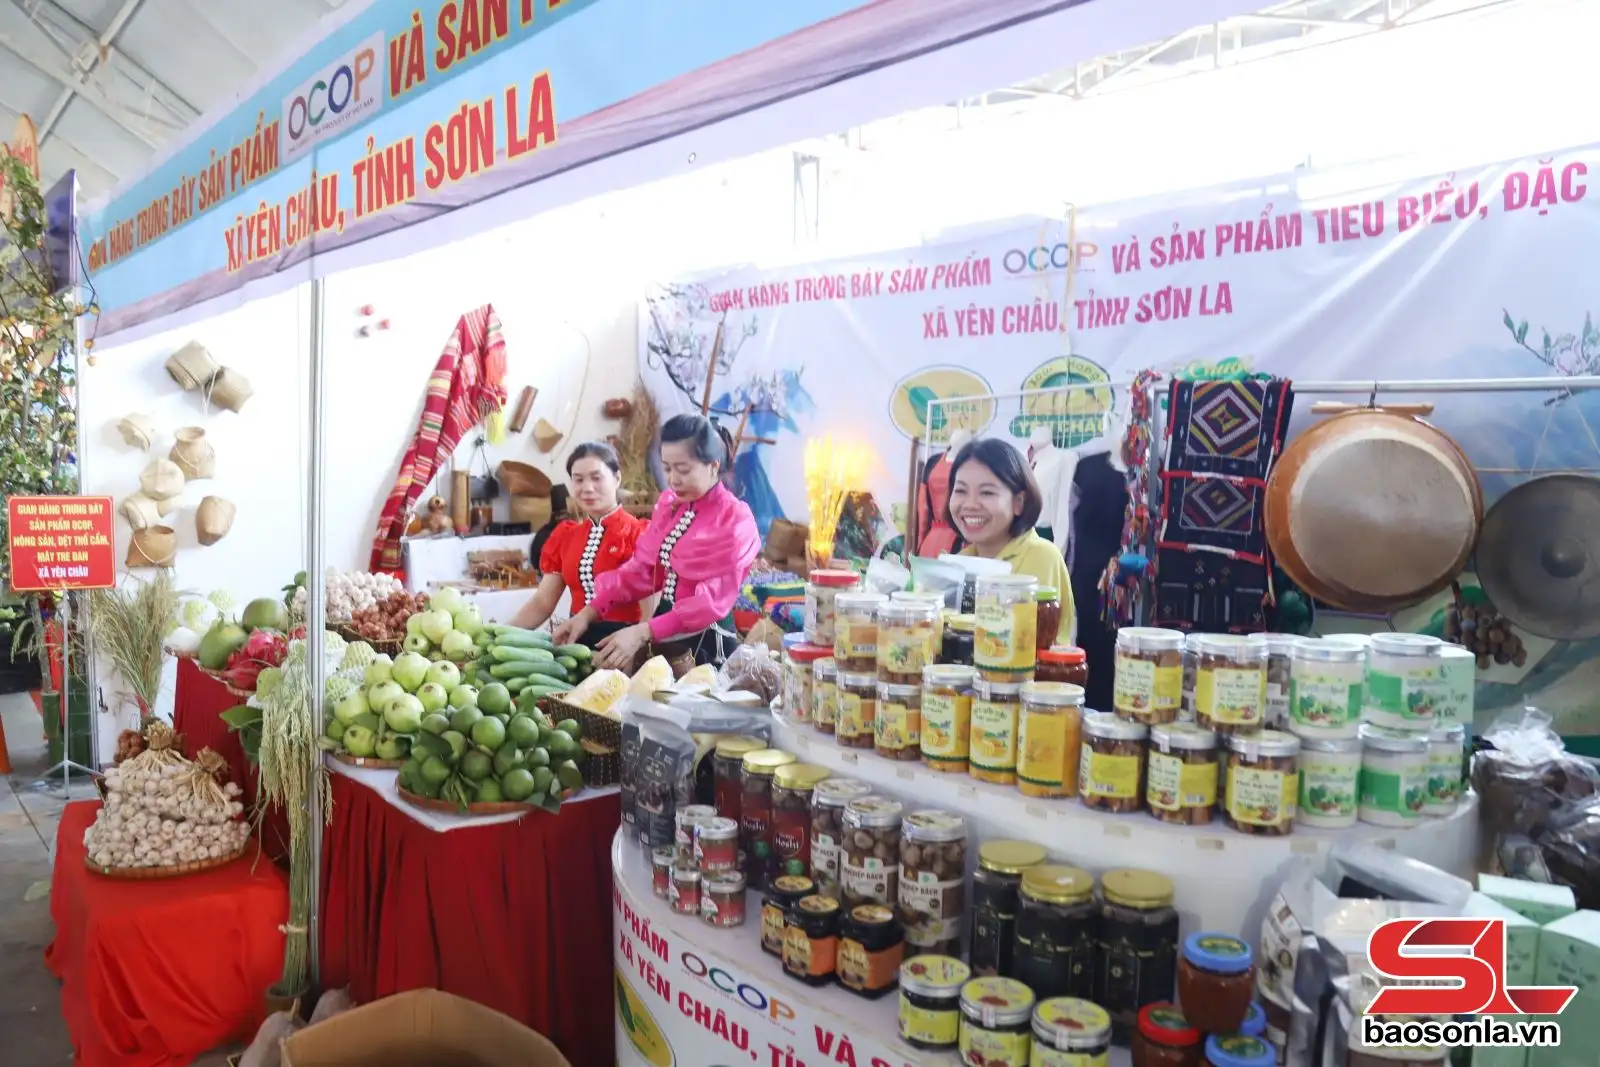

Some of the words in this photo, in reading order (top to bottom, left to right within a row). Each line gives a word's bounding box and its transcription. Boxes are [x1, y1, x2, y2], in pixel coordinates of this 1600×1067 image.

[172, 175, 196, 227] BÀY
[198, 148, 227, 211] SẢN
[289, 48, 375, 140] OCOP
[389, 11, 426, 98] VÀ
[246, 201, 281, 261] YÊN
[353, 135, 416, 219] TỈNH
[424, 98, 495, 190] SƠN
[506, 71, 556, 159] LA
[888, 257, 928, 295] SẢN
[1003, 242, 1098, 274] OCOP
[1111, 235, 1141, 275] VÀ
[1149, 221, 1206, 269] SẢN
[1214, 203, 1302, 257] PHẨM
[1502, 156, 1588, 217] ĐẶC
[922, 305, 949, 340] XÃ
[954, 302, 996, 339] YÊN
[1073, 289, 1131, 331] TỈNH
[1134, 285, 1193, 324] SƠN
[1199, 281, 1234, 318] LA
[13, 533, 36, 547] NÔNG
[18, 504, 37, 515] GIAN
[38, 502, 60, 515] HÀNG
[89, 502, 103, 514] BÀY
[51, 565, 67, 578] YÊN
[67, 564, 89, 577] CHÂU
[56, 551, 71, 562] TRE
[624, 902, 669, 964] PHẨM
[681, 951, 796, 1020] OCOP
[814, 1024, 858, 1067] VÀ
[637, 951, 671, 1005] YÊN
[678, 990, 758, 1062] CHÂU,
